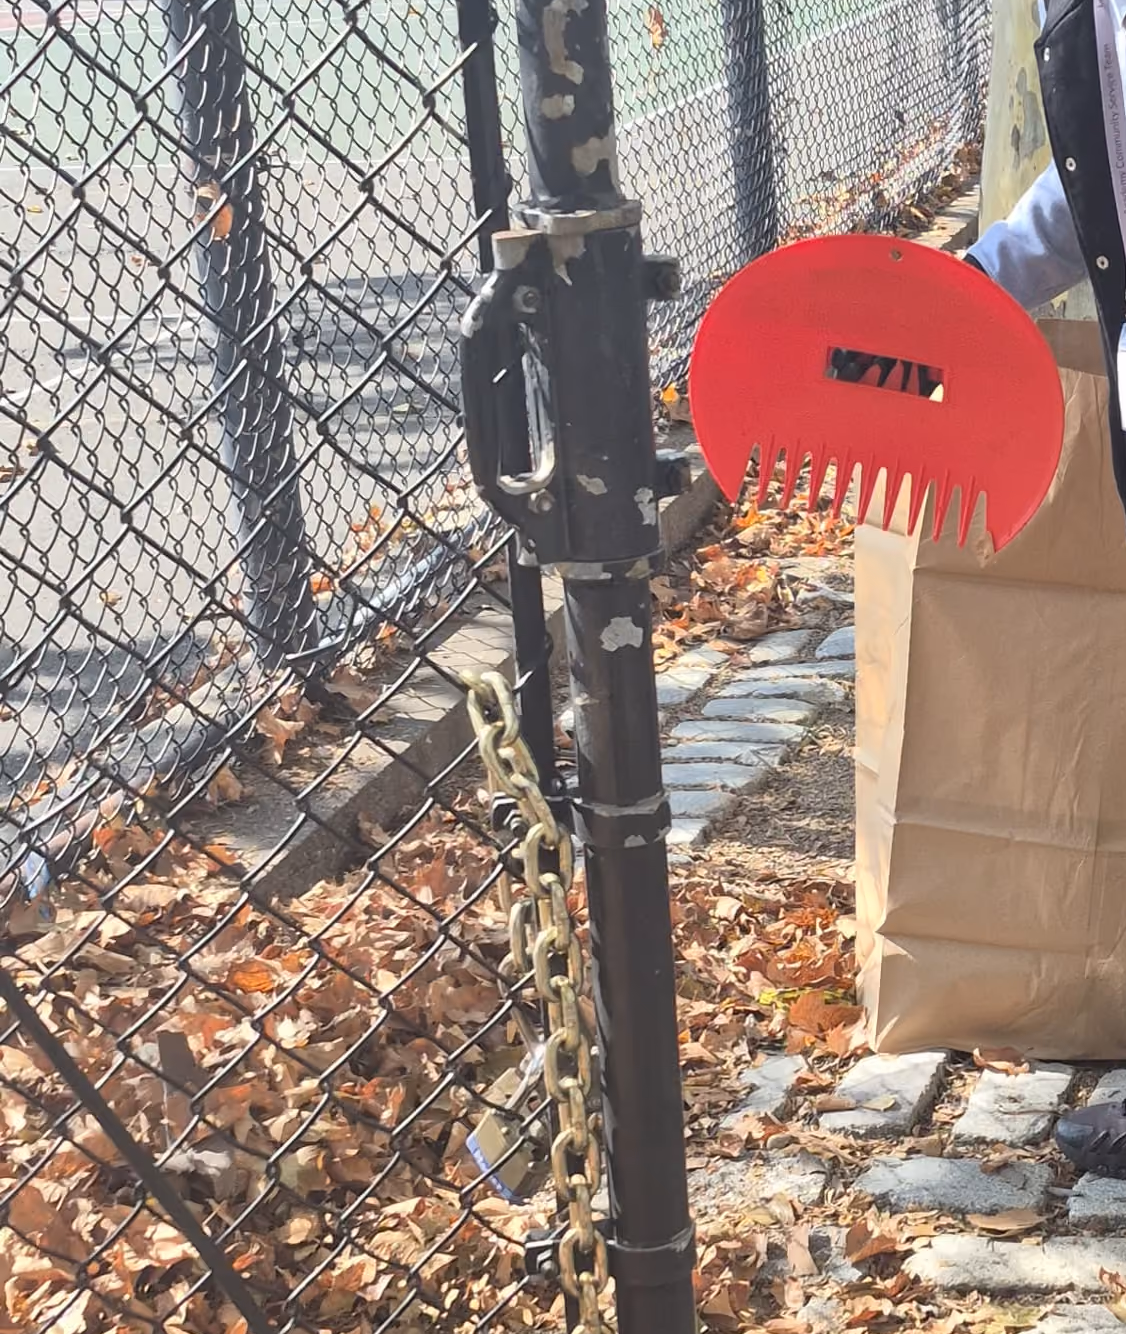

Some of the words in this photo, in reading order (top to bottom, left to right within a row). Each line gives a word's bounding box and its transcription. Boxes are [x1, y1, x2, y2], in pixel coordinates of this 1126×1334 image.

[1103, 43, 1113, 71] Team
[1106, 72, 1118, 110] Service
[1109, 111, 1125, 169] Community
